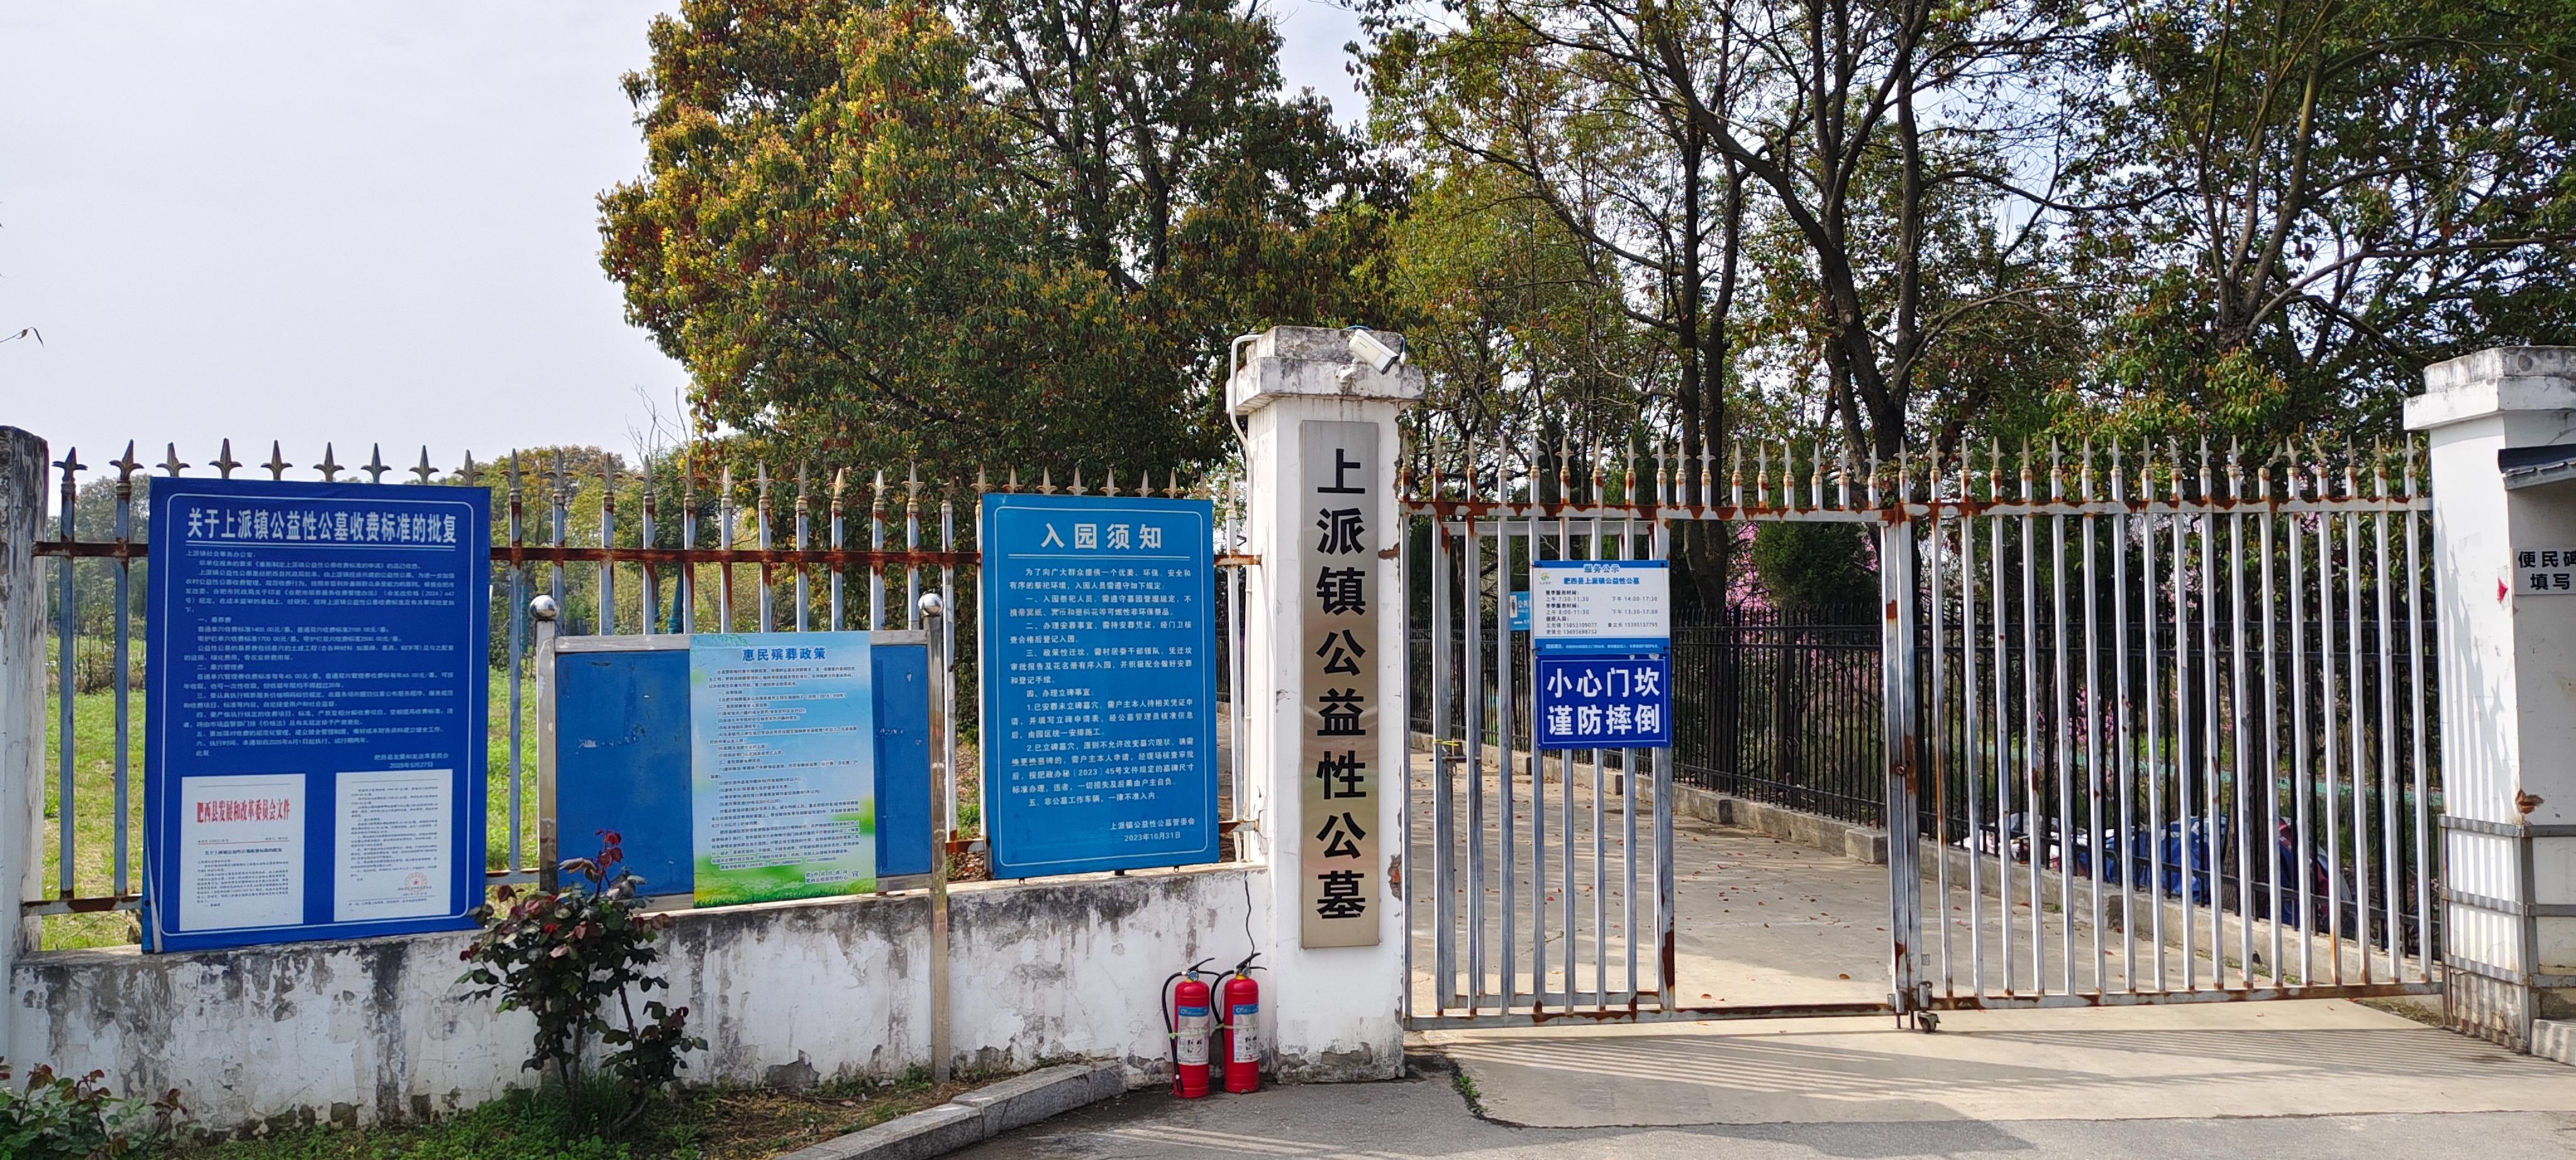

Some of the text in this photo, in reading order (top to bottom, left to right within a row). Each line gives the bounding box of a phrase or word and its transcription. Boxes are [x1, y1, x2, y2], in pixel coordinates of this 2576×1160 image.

[187, 506, 457, 544] 关于上派镇公益性公墓收费标准的批复
[1041, 523, 1162, 549] 入园须知
[1584, 564, 1620, 573] 服务公示
[742, 647, 826, 661] 惠民殡葬政策
[1316, 449, 1366, 919] 上派镇公益性公墓
[1547, 667, 1660, 698] 小心门坎
[1547, 704, 1660, 735] 谨防摔倒
[197, 798, 291, 823] 肥西县发展和改革委员会文件
[1124, 831, 1181, 842] 2023年10月31日
